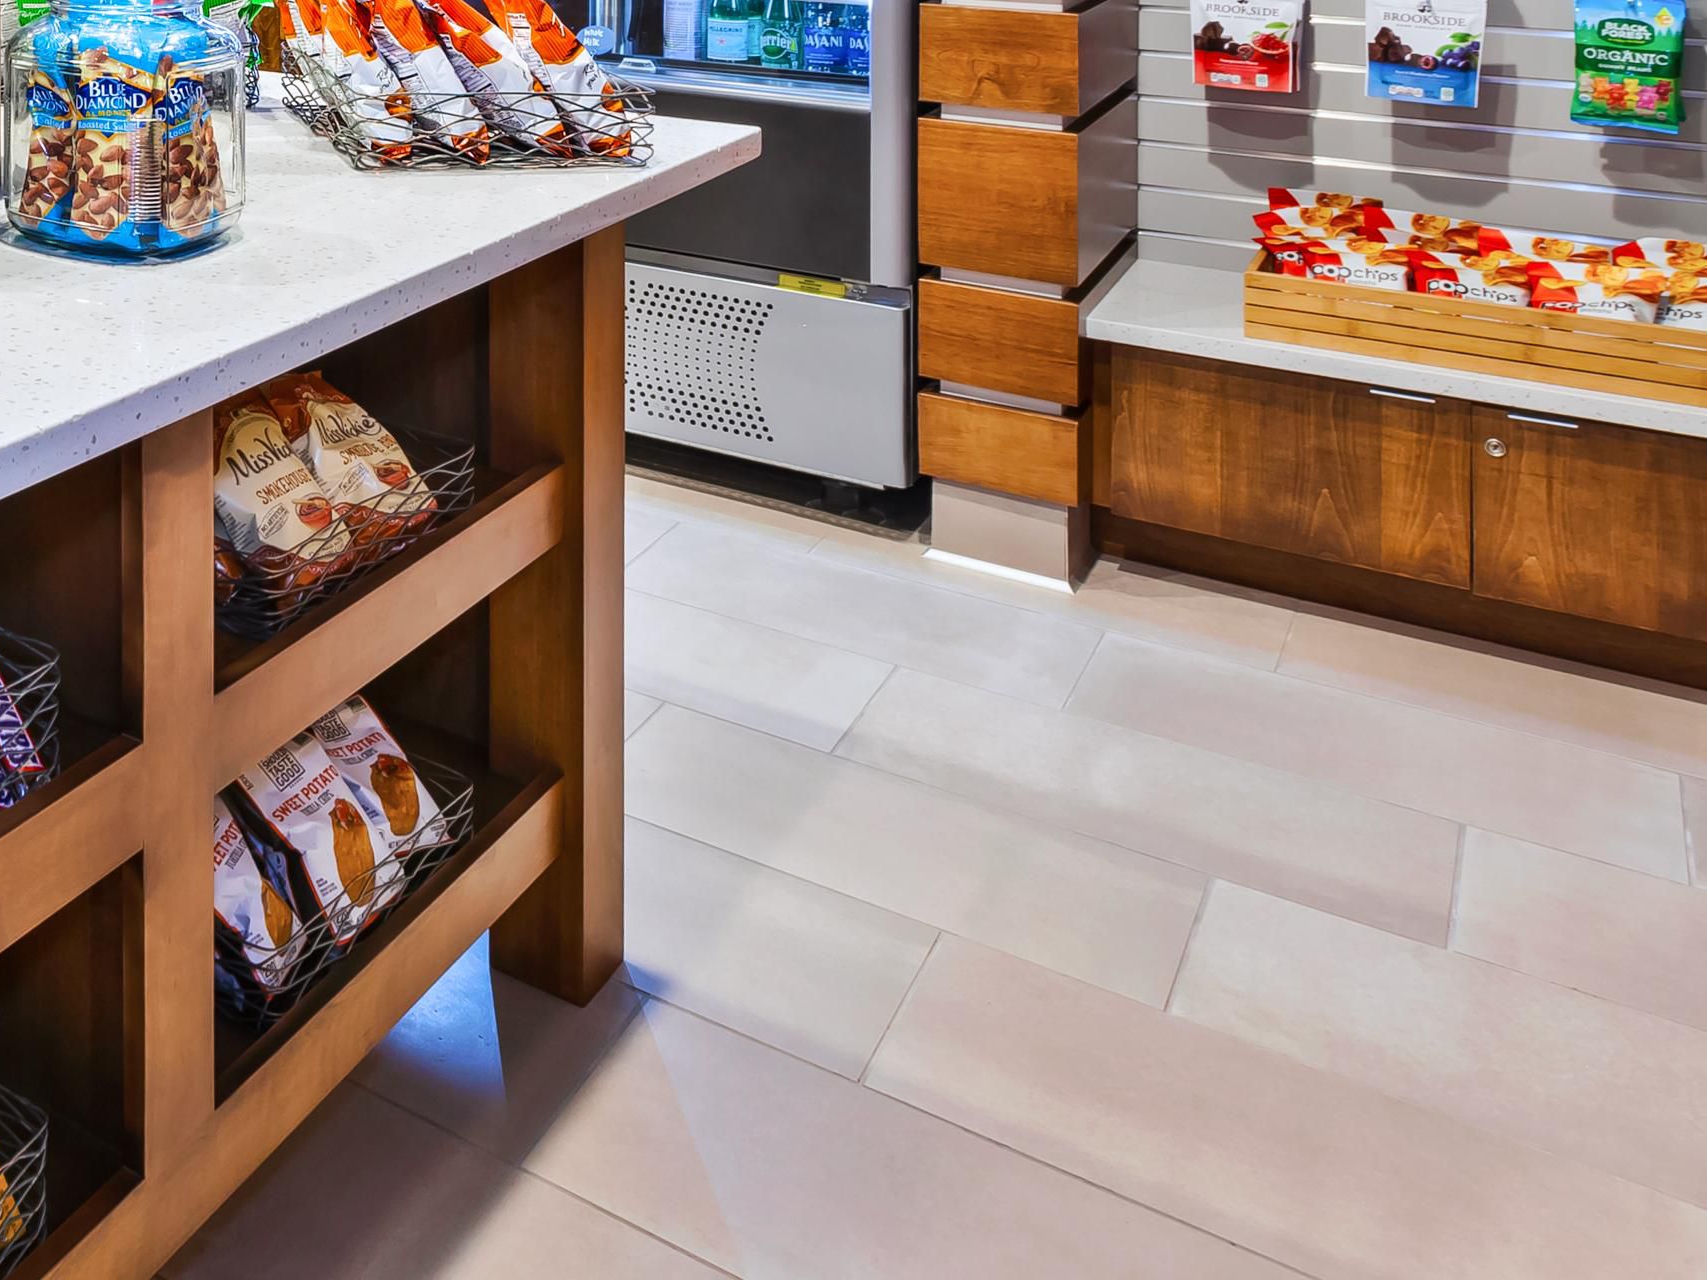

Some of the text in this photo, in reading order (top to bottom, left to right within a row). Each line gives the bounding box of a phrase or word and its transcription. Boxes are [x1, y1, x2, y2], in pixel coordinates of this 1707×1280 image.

[1206, 3, 1280, 17] BROOKSIDE
[1383, 11, 1466, 27] BROOKSIDE
[1604, 21, 1648, 32] BLACK
[761, 33, 792, 49] errier
[1601, 29, 1653, 40] FOREST
[849, 36, 870, 53] DAS
[1583, 48, 1669, 65] ORGANIC
[89, 80, 127, 97] BLUE
[76, 93, 147, 110] DIAMOND
[268, 756, 297, 780] TASTE
[275, 763, 305, 790] GOOD
[271, 764, 340, 822] SWEET POTATO
